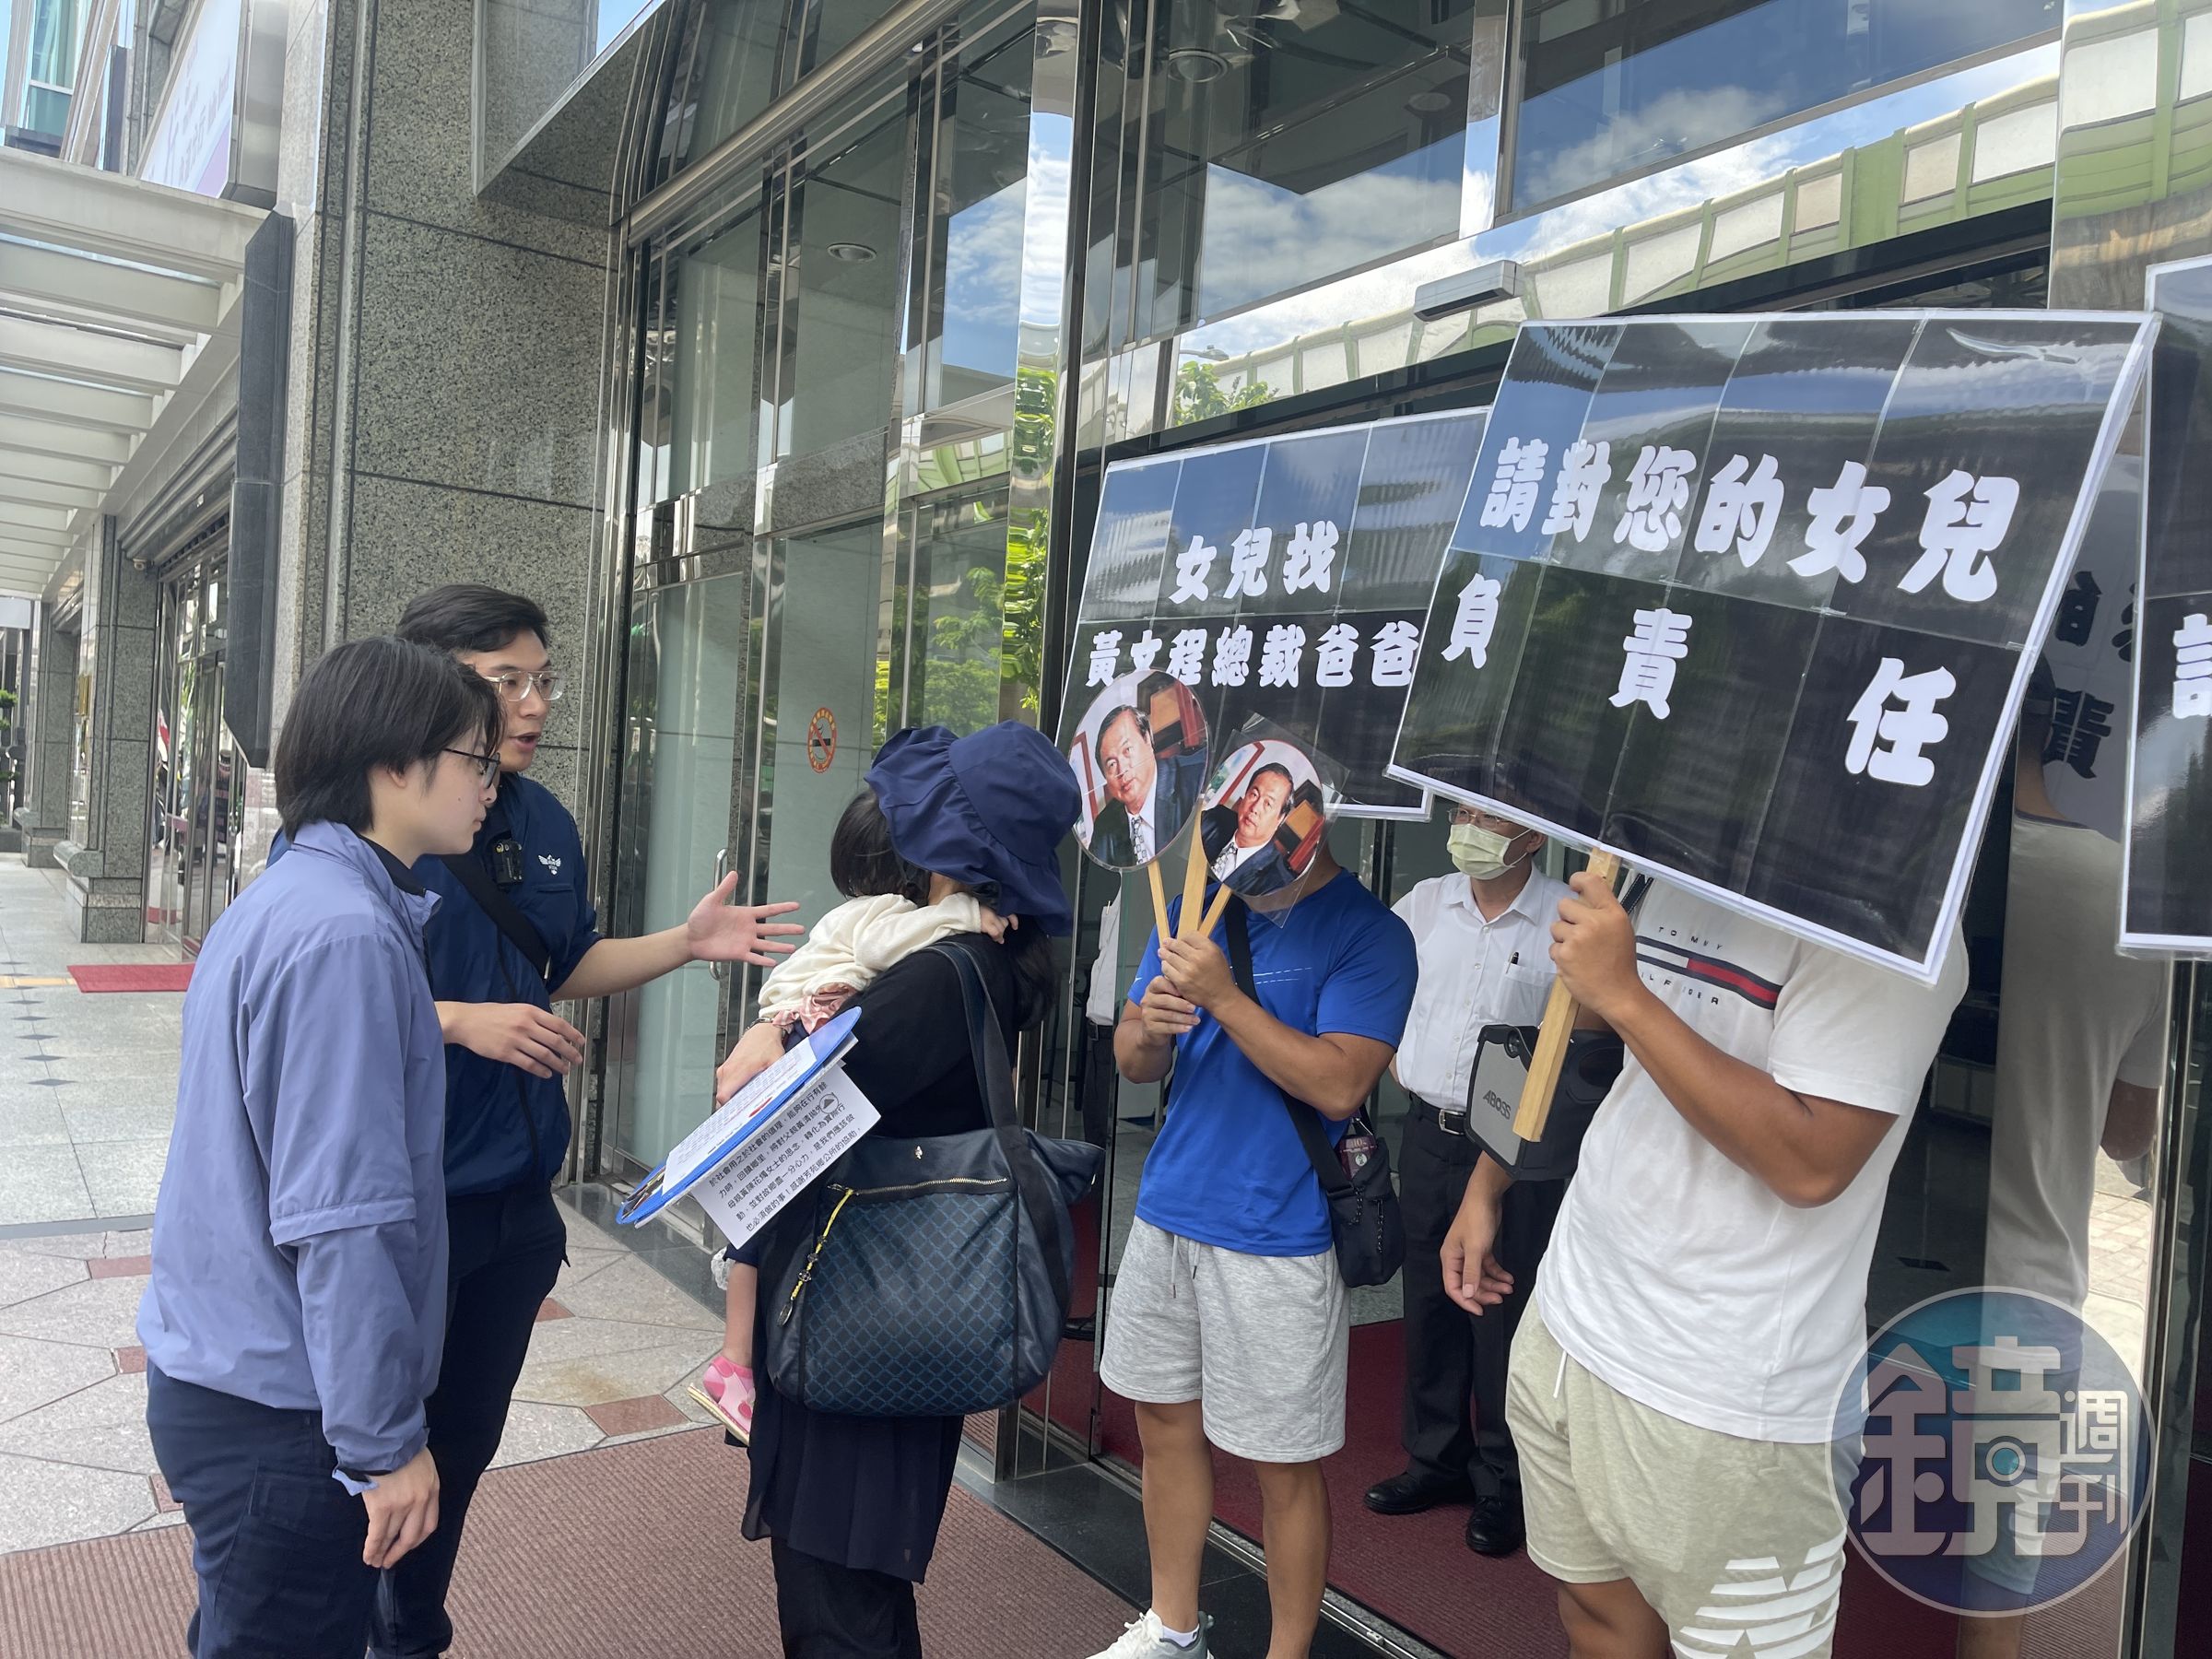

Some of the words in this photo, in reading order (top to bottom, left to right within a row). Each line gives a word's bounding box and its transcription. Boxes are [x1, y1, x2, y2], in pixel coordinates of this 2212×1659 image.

[1169, 520, 1339, 605] 女兒找
[1479, 437, 2020, 603] 請對您的女兒
[1085, 620, 1420, 688] 黃文程總裁爸爸
[1441, 572, 1958, 787] 負責任
[1483, 1089, 1512, 1120] ABOSS
